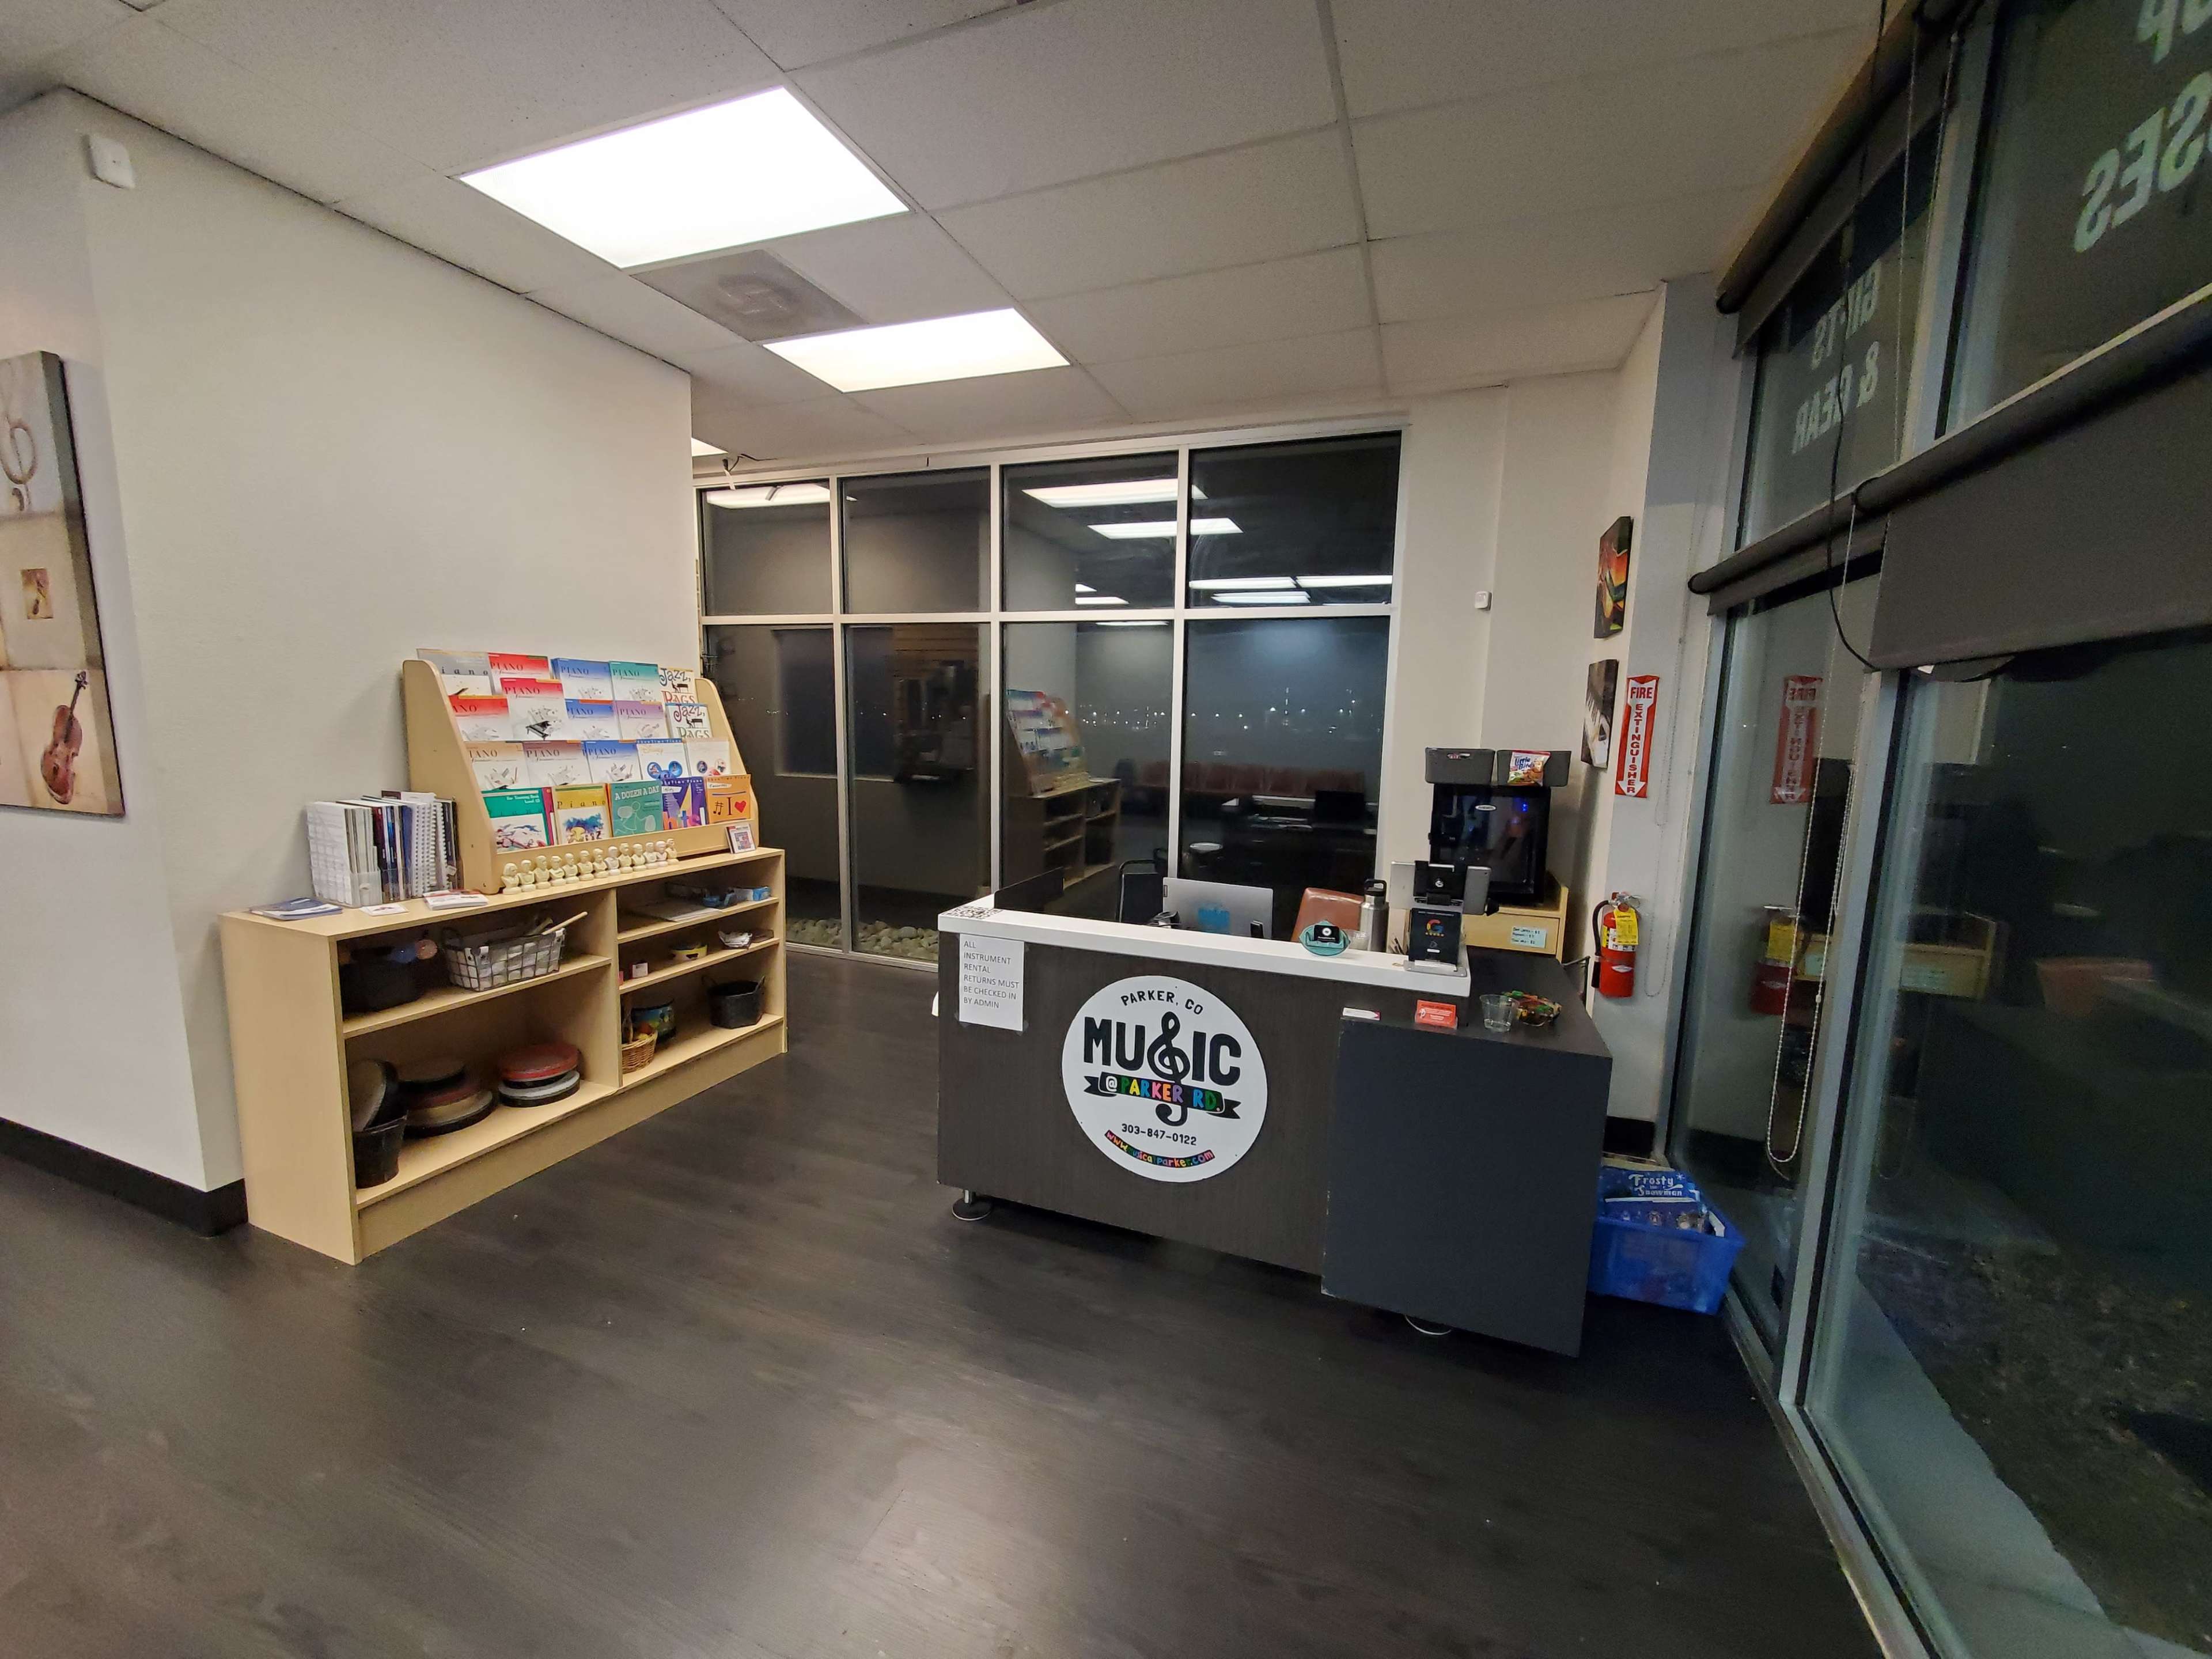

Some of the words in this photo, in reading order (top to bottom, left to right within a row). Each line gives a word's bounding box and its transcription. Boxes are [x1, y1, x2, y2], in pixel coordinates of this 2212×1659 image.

[442, 666, 488, 675] iano
[560, 666, 589, 675] PIANO
[612, 669, 641, 677] PIANO
[503, 687, 540, 695] PIANO
[1630, 687, 1653, 699] FIRE
[469, 749, 498, 758] IANO
[527, 749, 560, 757] PIANO
[1627, 703, 1644, 793] EXTINGUISHER
[643, 787, 648, 796] A
[648, 785, 660, 794] DAY
[964, 952, 1012, 964] INSTRUMENT
[964, 963, 991, 974] RENTAL
[964, 974, 996, 985] RETURNS
[998, 979, 1019, 988] MUST
[974, 987, 1006, 998] CHECKED
[1009, 992, 1016, 1000] IN
[974, 999, 999, 1008] ADMIN
[1185, 999, 1203, 1015] CO
[1105, 1075, 1184, 1103] @PARKER
[1122, 1123, 1197, 1145] 303-847-0122
[1628, 1174, 1683, 1190] Frosty
